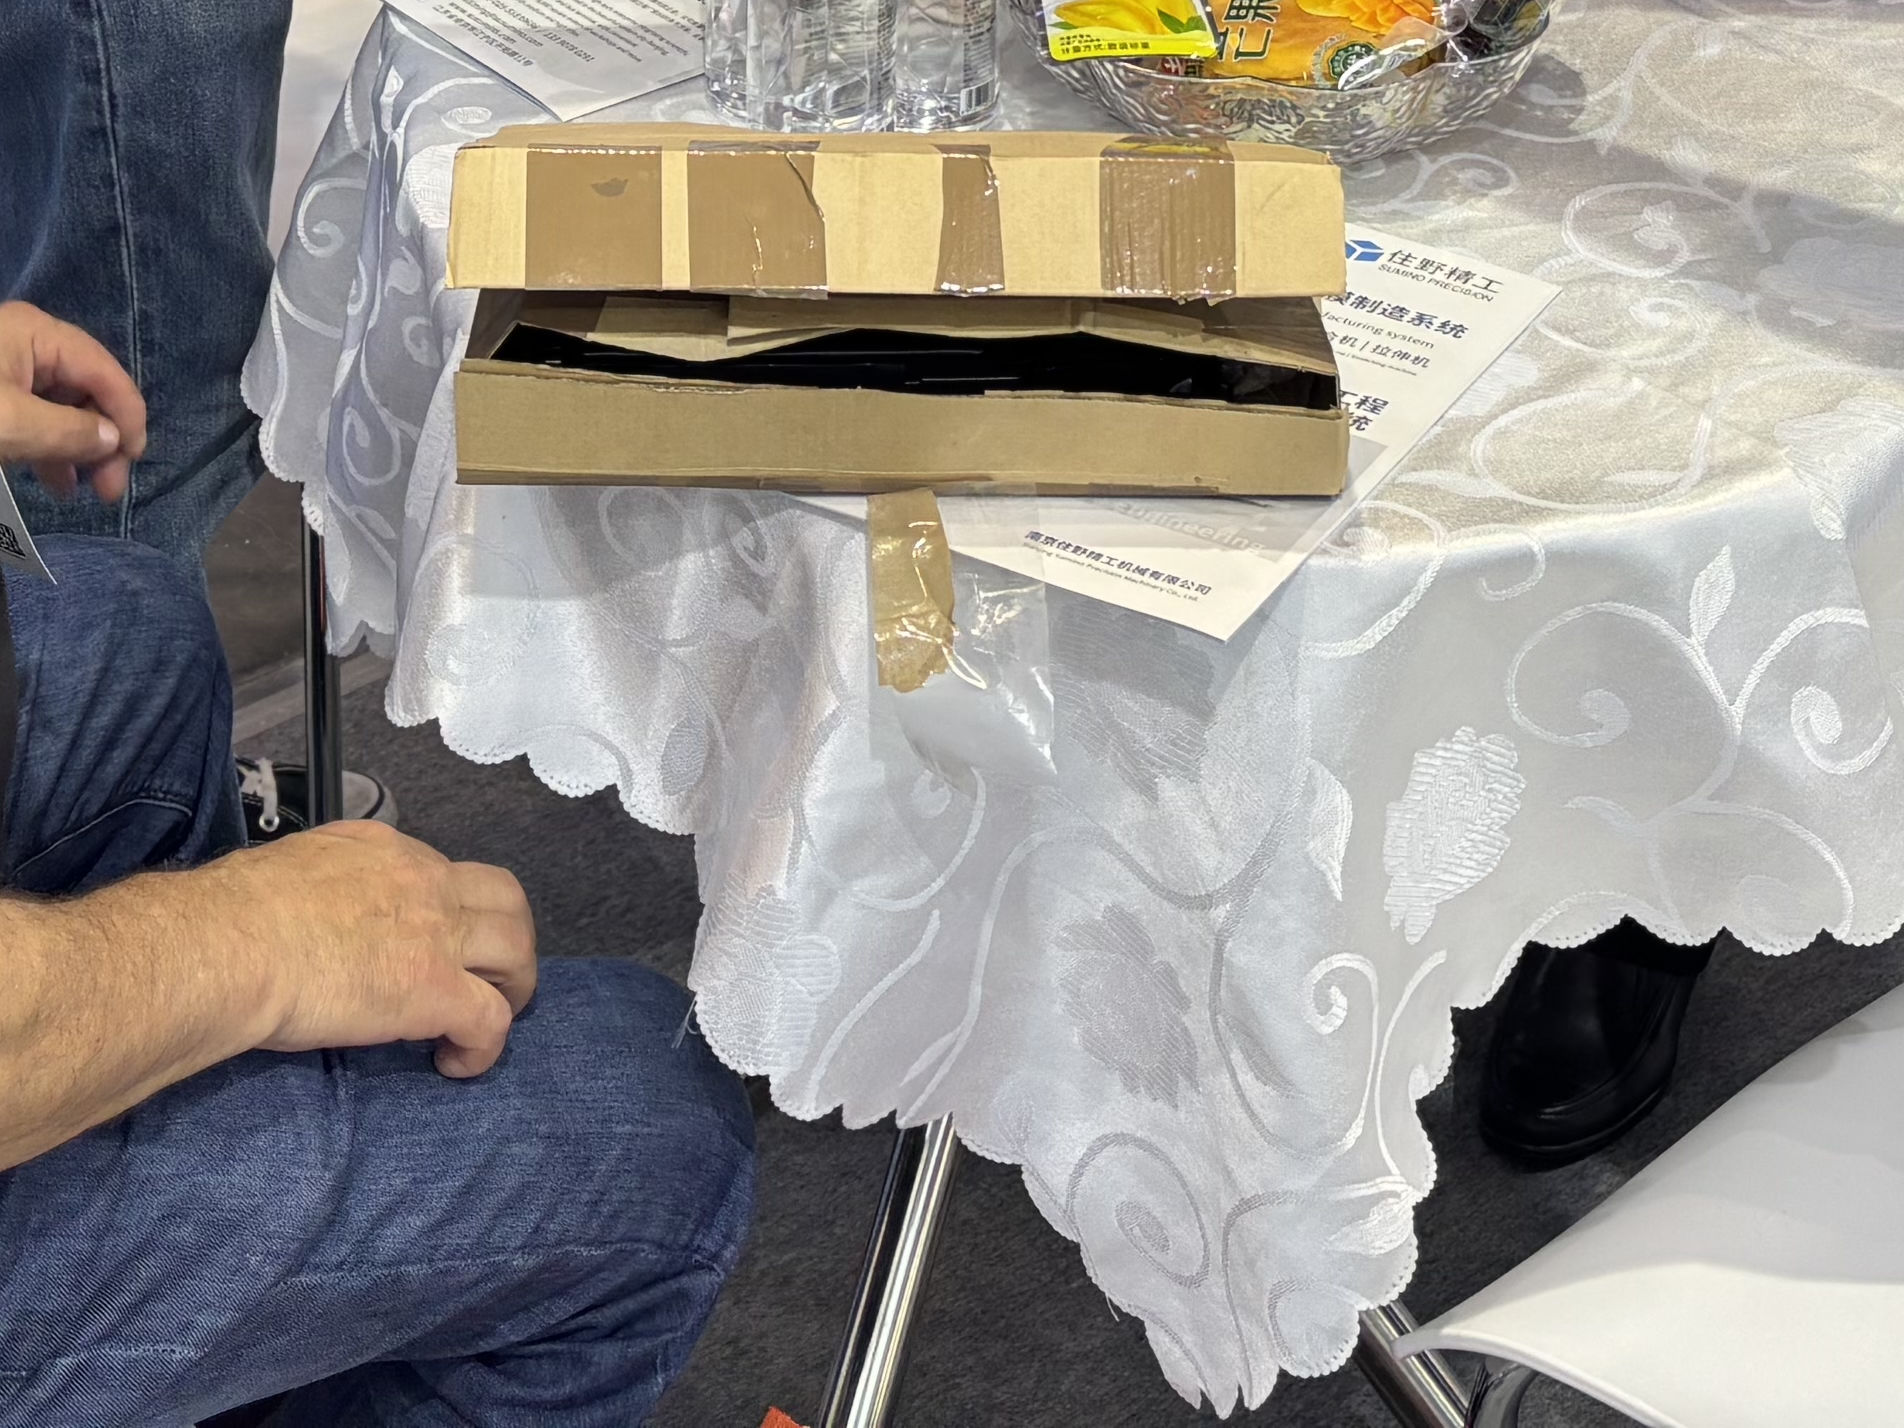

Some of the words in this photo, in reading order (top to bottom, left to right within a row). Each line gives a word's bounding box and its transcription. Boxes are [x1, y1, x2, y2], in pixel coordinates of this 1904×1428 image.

[1378, 263, 1426, 283] SUMINO
[1427, 277, 1495, 302] PRECISION
[1387, 249, 1504, 294] 住野精工
[1370, 343, 1431, 369] 拉伸机
[1387, 330, 1435, 350] system
[1024, 529, 1213, 596] 南京住野精工机械有限公司
